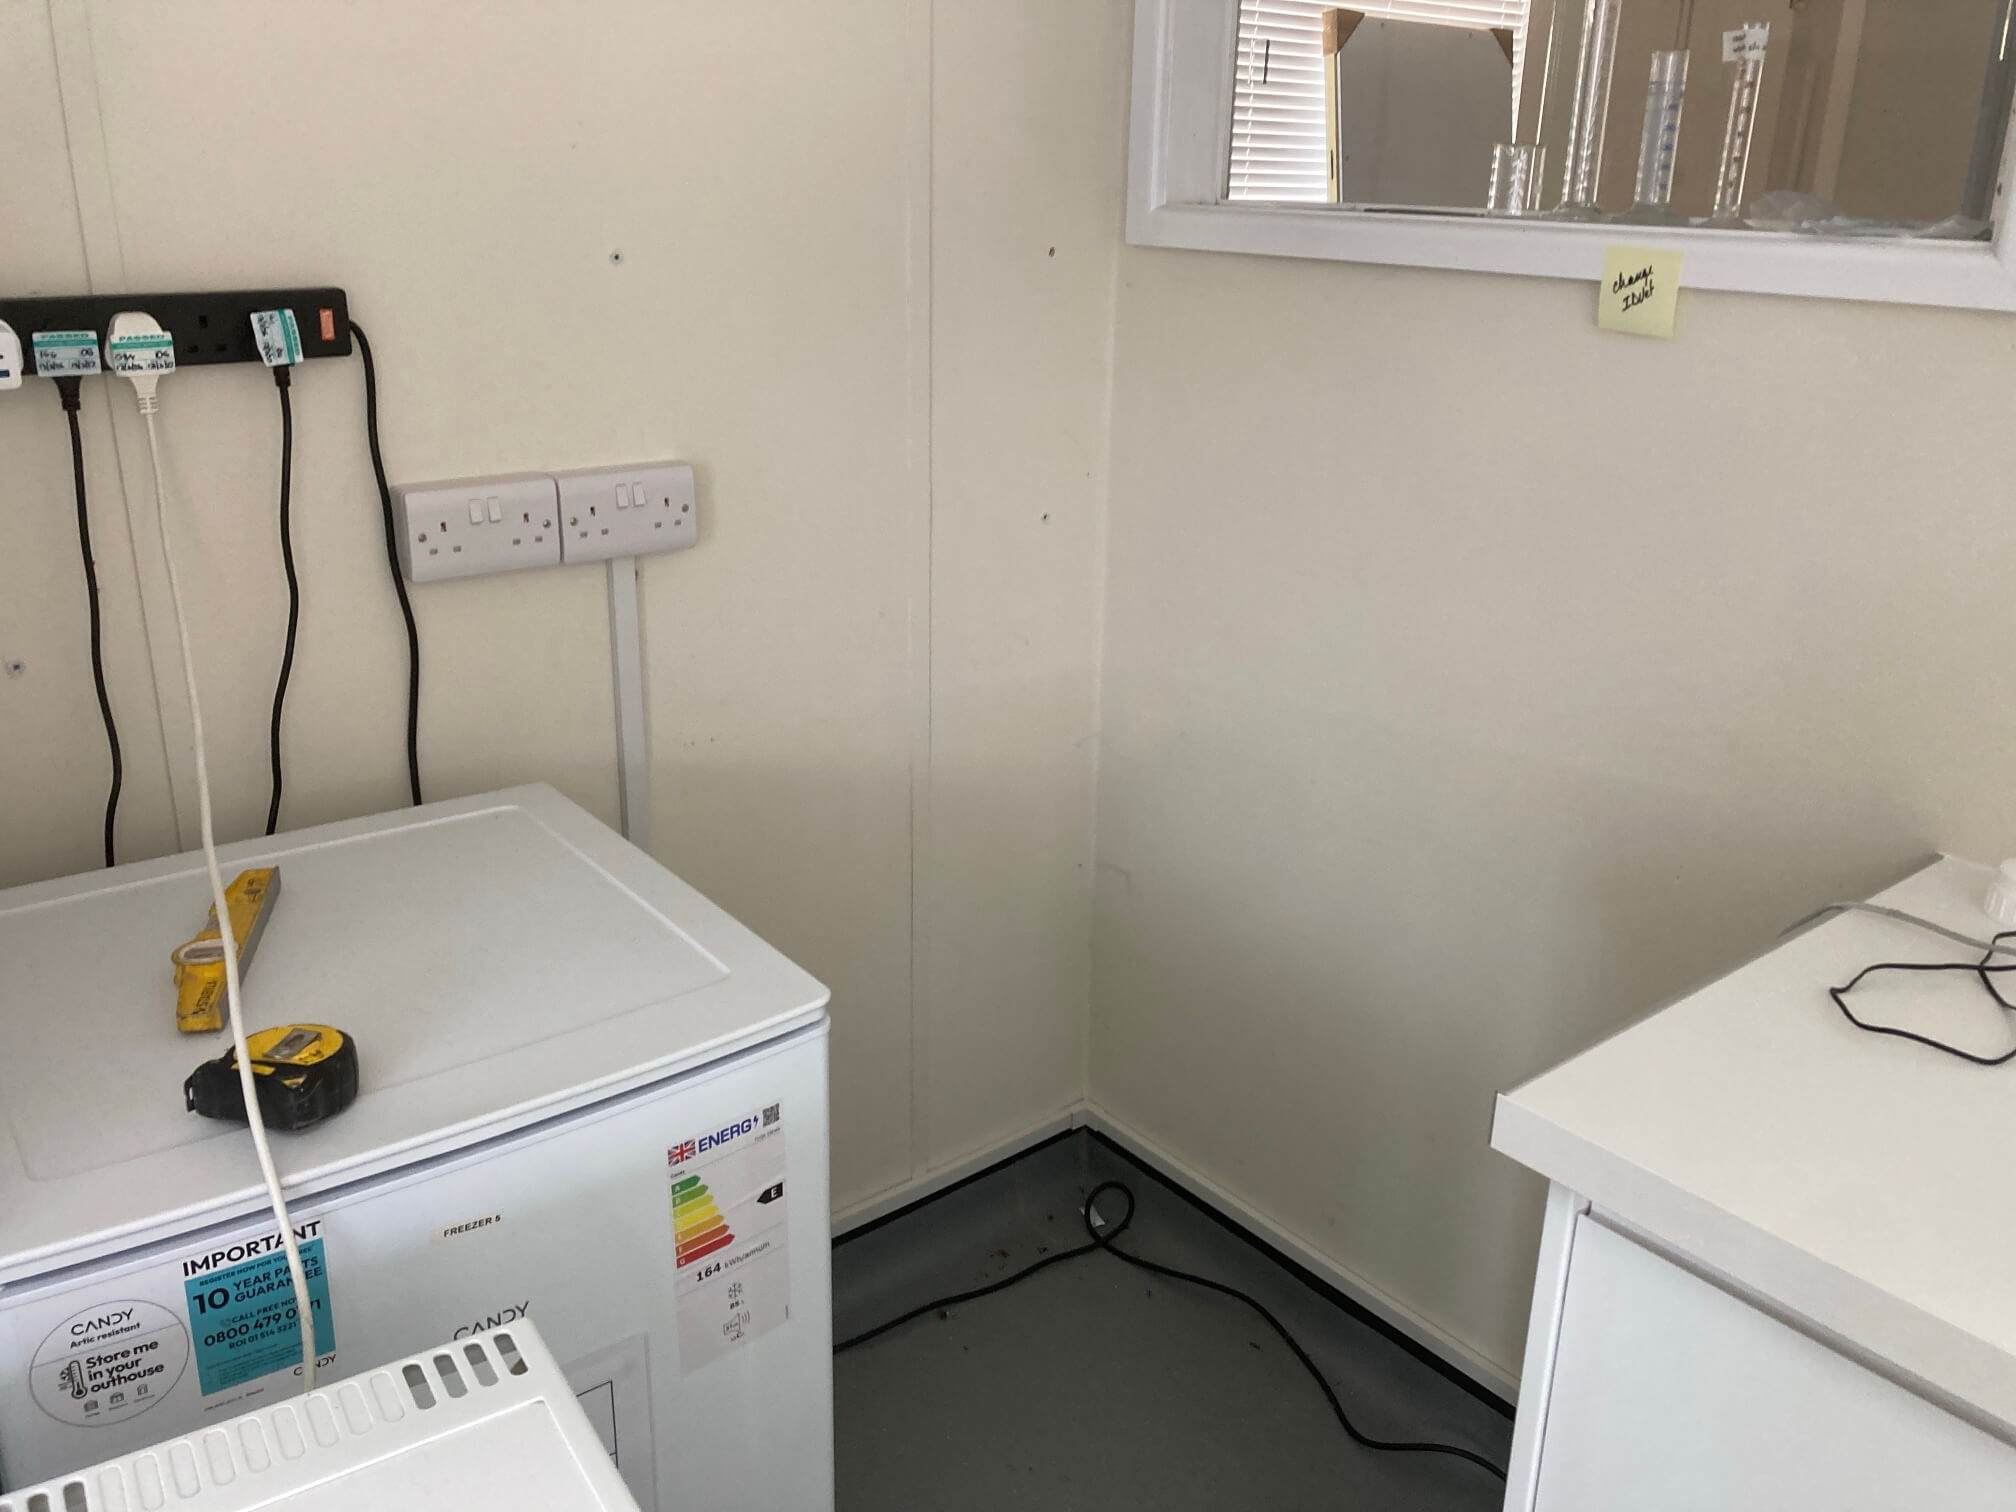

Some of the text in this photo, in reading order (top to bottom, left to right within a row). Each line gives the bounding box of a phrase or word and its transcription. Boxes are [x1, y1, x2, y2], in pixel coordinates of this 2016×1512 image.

[771, 1187, 778, 1198] E
[443, 1217, 492, 1238] FREEZER
[193, 1256, 319, 1315] 10 YEAR PATS
[234, 1266, 323, 1303] GUARANEE
[696, 1262, 721, 1283] 164
[71, 1308, 133, 1336] CANDY
[231, 1297, 297, 1324] CALL FREE NO
[453, 1300, 529, 1341] CANDY
[70, 1322, 141, 1349] Artic resistant
[204, 1324, 249, 1347] 0800
[253, 1313, 281, 1329] 479
[229, 1338, 246, 1349] ROI
[86, 1341, 159, 1369] Store me
[293, 1354, 336, 1376] CNDY
[88, 1358, 142, 1381] in your
[90, 1364, 165, 1392] outhouse
